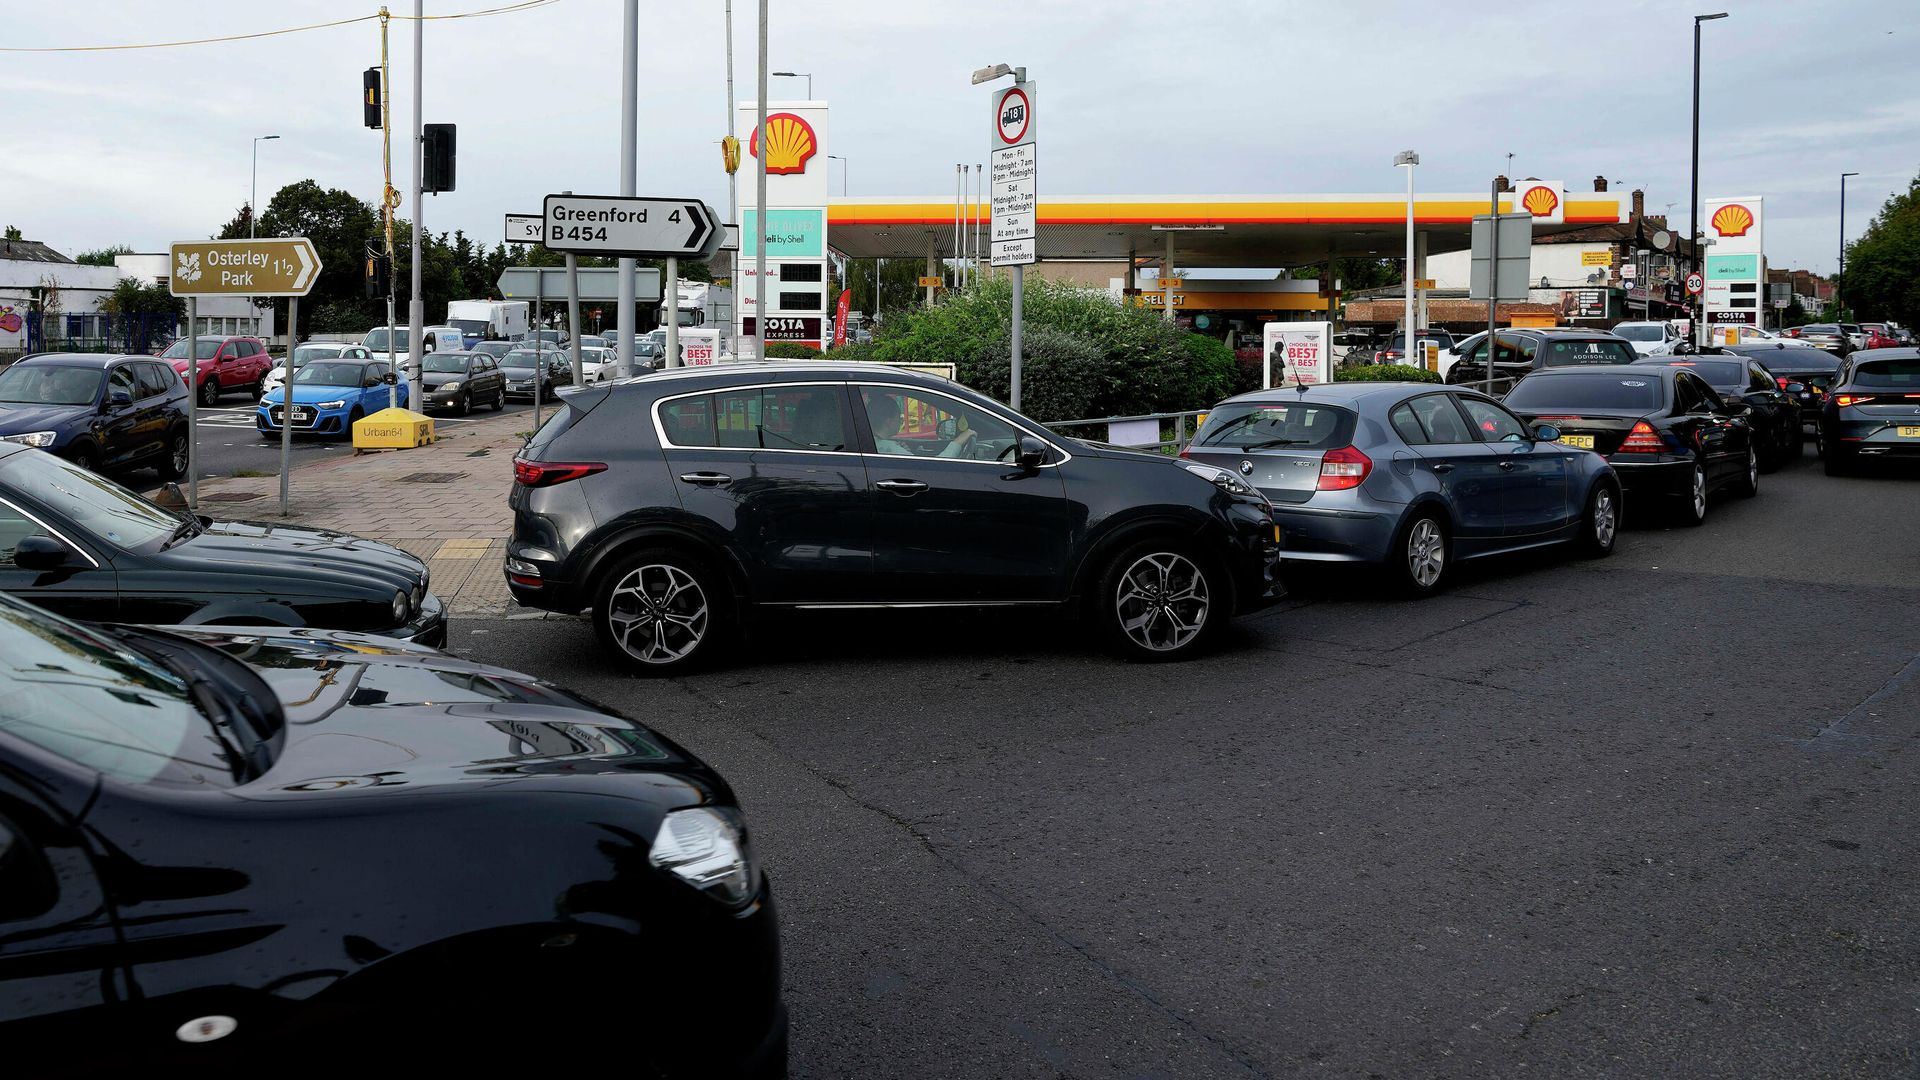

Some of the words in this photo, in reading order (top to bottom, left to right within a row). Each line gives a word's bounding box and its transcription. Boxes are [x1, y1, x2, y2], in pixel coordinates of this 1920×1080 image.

[994, 162, 1017, 172] Midnight
[1010, 168, 1034, 178] Midnight
[994, 195, 1017, 204] Midnight
[1008, 202, 1032, 211] Midnight
[553, 206, 648, 223] Greenford
[668, 210, 681, 224] 4
[765, 235, 776, 243] eli
[778, 235, 787, 245] by
[788, 235, 804, 243] Shell
[1004, 244, 1022, 252] Except
[207, 250, 270, 268] Osterley
[993, 254, 1010, 263] permit
[1012, 252, 1032, 260] holders
[221, 270, 254, 286] Park
[1688, 280, 1701, 288] 30
[688, 350, 712, 358] BEST
[1289, 348, 1318, 358] BEST
[363, 428, 402, 438] Urban64
[1569, 437, 1592, 447] EPC
